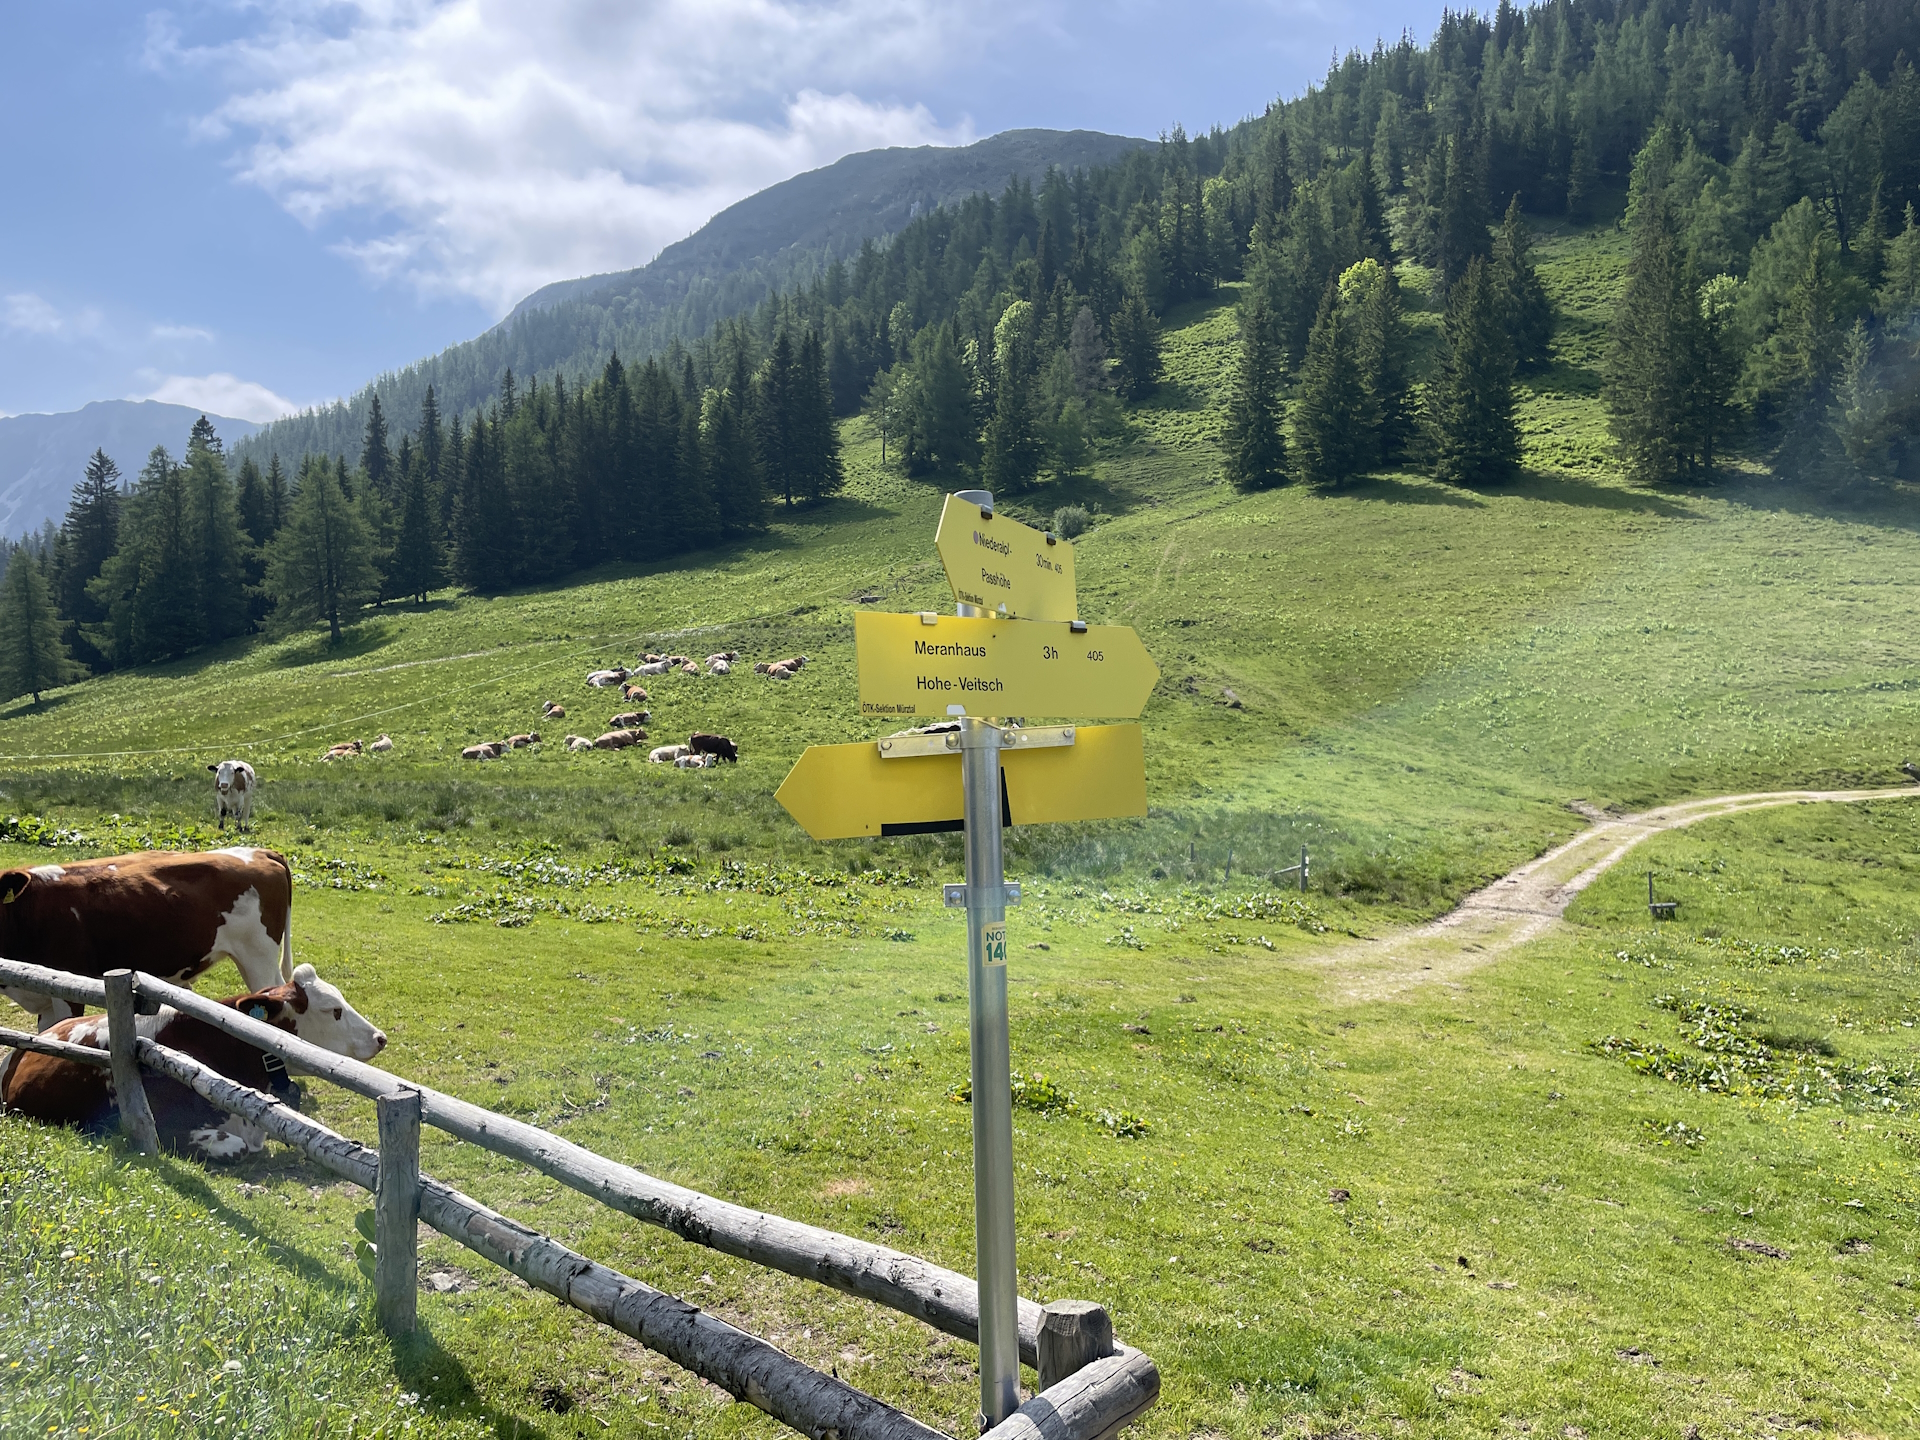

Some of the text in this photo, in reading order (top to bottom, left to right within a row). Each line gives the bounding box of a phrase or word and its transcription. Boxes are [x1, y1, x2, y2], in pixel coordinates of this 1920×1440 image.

[982, 567, 1010, 590] Passhöhe
[915, 640, 986, 657] Meranhaus
[1087, 650, 1104, 661] 405
